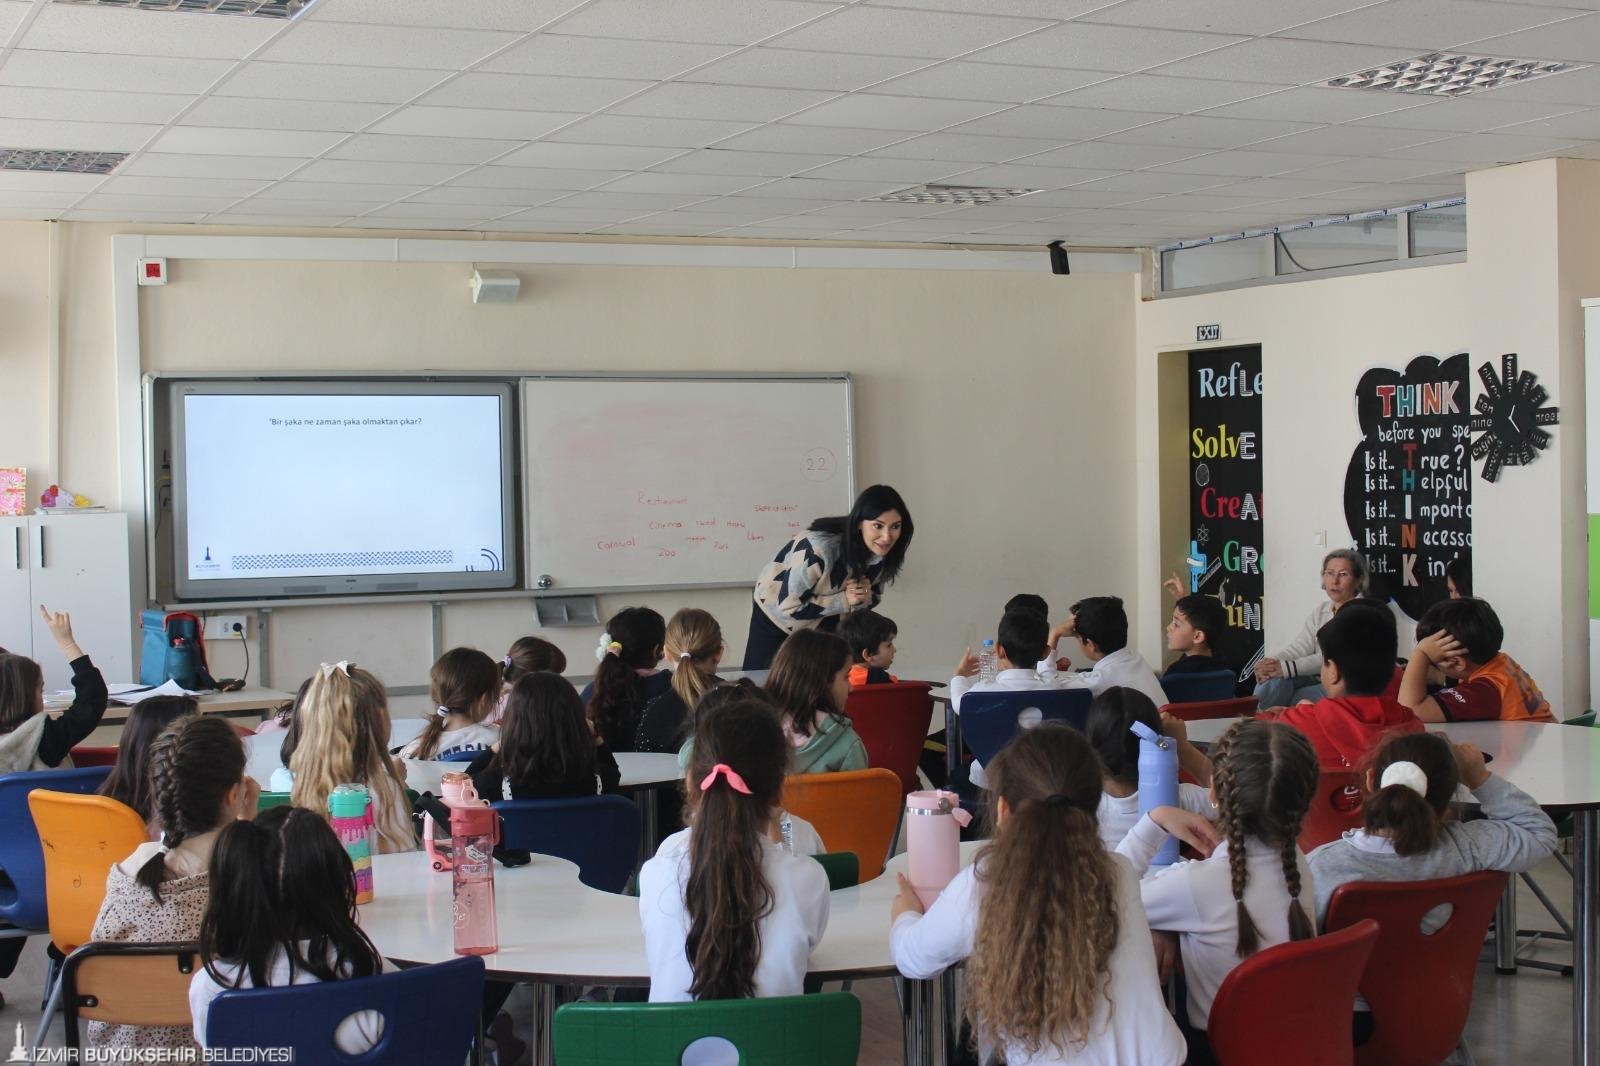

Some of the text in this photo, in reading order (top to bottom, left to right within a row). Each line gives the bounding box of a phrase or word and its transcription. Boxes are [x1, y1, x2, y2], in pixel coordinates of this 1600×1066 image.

[1199, 326, 1218, 340] EXIT
[1376, 381, 1460, 418] THINK
[284, 418, 302, 427] şaka
[343, 418, 361, 427] şaka
[362, 418, 398, 426] olmaktan
[1471, 418, 1493, 428] nine
[1192, 424, 1256, 460] SolvE
[1378, 420, 1415, 444] before
[1421, 427, 1442, 445] you
[1365, 451, 1376, 471] Is
[1365, 474, 1376, 493] Is
[1365, 501, 1376, 520] Is
[1365, 528, 1377, 549] Is
[1365, 554, 1376, 573] Is
